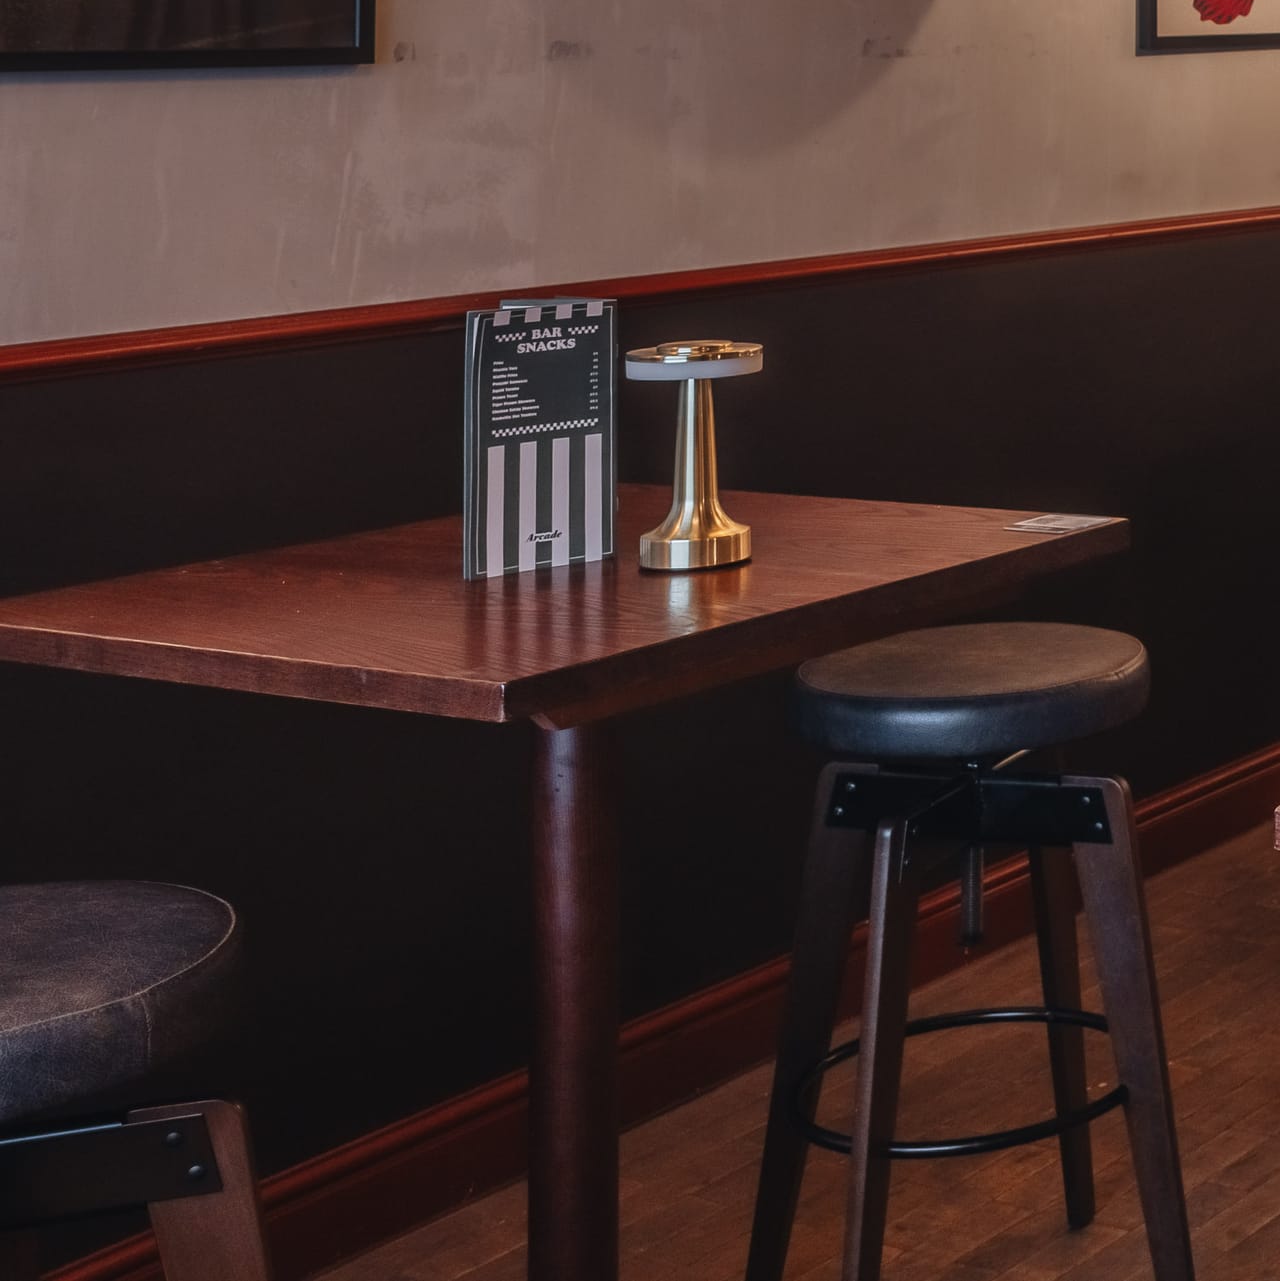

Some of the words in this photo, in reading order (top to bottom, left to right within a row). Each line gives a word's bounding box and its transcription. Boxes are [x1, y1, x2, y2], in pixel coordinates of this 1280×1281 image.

[532, 327, 562, 340] BAR
[516, 338, 576, 354] SNACKS
[527, 529, 562, 542] Arcade
